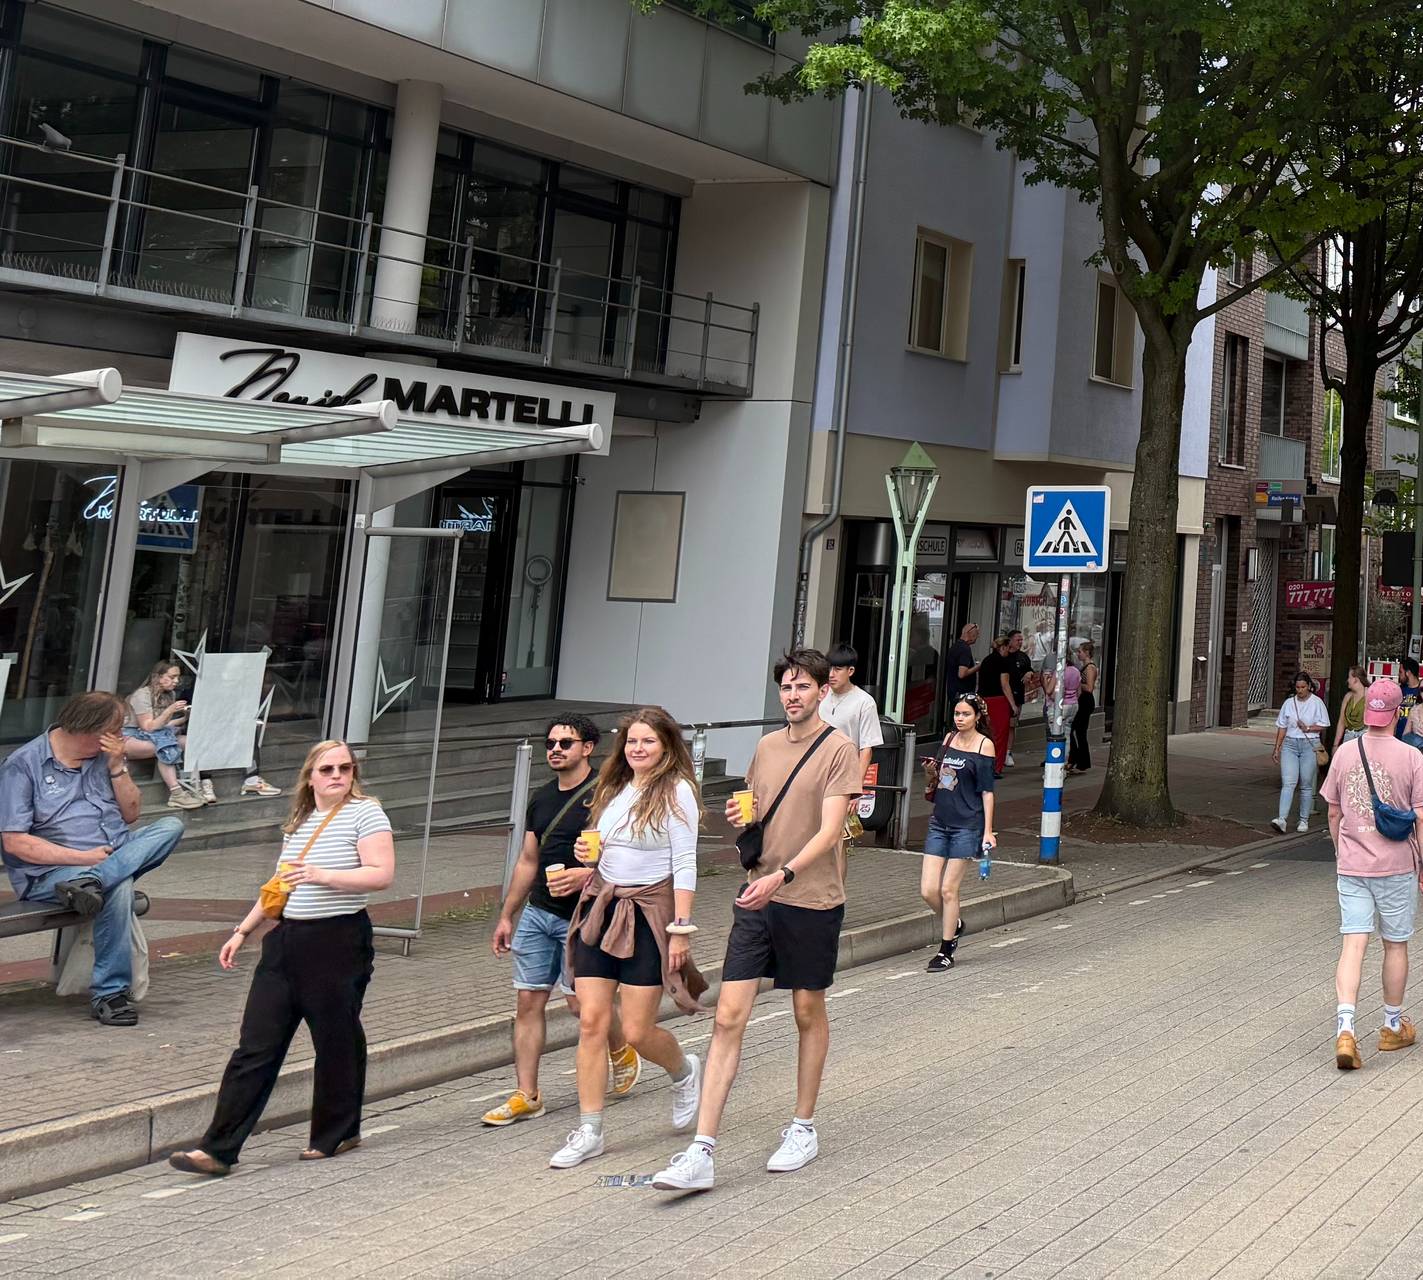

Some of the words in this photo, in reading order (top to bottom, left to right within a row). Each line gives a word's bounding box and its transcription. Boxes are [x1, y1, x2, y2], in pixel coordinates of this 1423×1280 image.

[383, 377, 594, 427] MARTELLI
[918, 539, 945, 552] SCHULE
[1288, 583, 1304, 591] 0201
[1289, 590, 1310, 604] 777
[1314, 587, 1335, 600] 777
